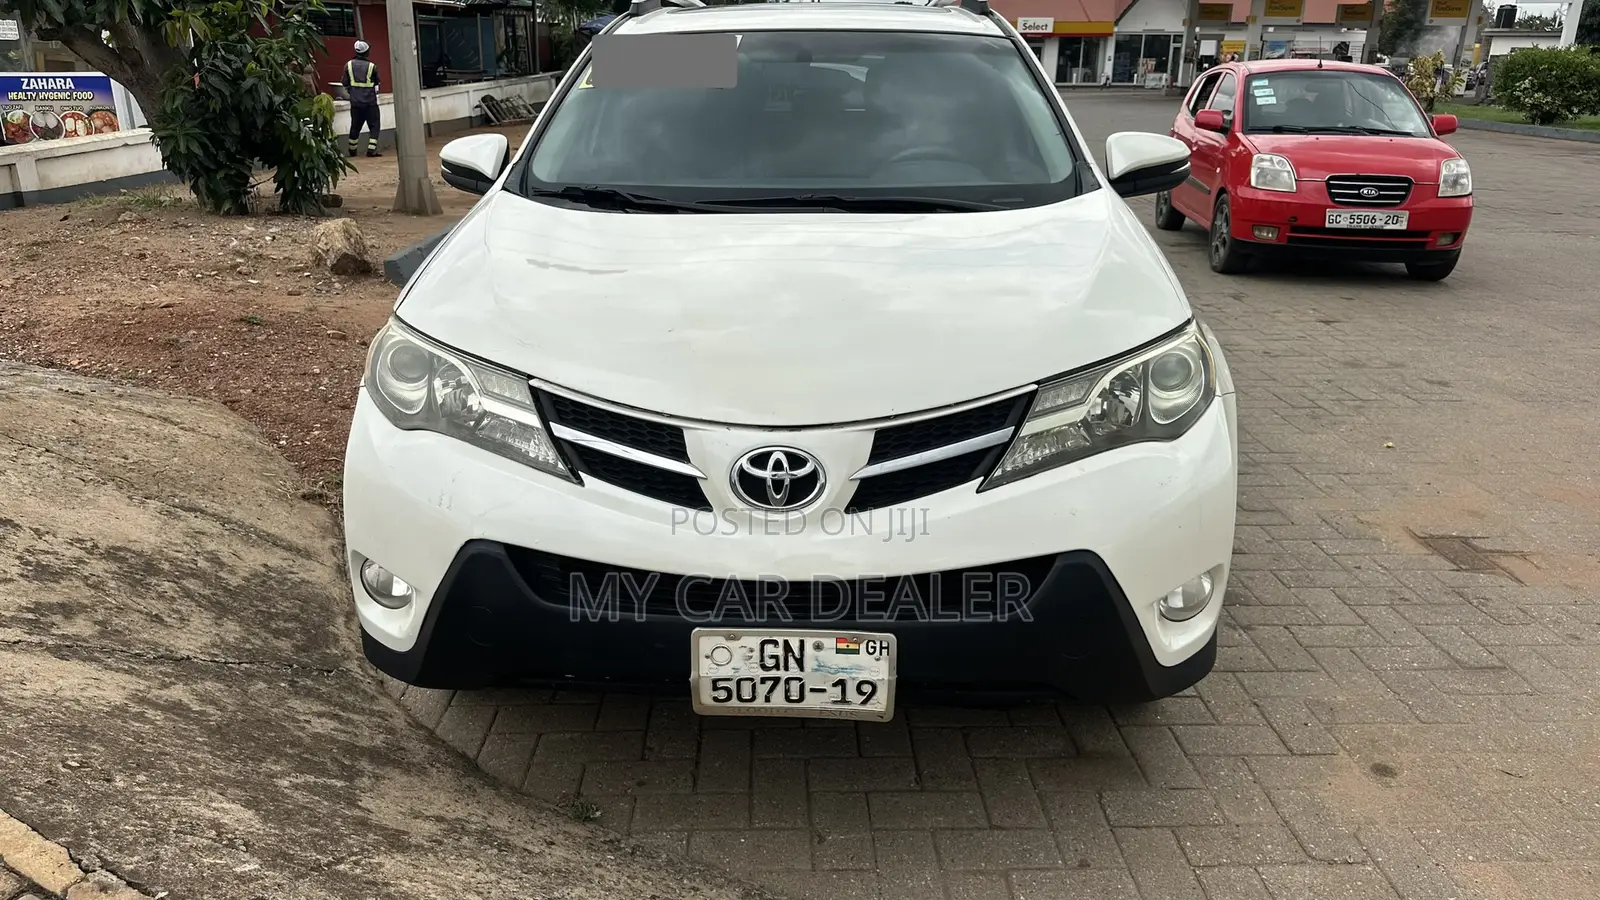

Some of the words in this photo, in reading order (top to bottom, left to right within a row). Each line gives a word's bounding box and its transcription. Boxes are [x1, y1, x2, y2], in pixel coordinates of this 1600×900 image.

[1022, 22, 1048, 31] Select
[20, 78, 75, 90] ZAHARA
[8, 91, 37, 100] HEALTY
[39, 91, 71, 100] HYGENIC
[73, 91, 94, 100] FOOD
[1328, 214, 1342, 225] GC
[866, 639, 889, 656] GH
[759, 639, 805, 672] GN
[711, 676, 878, 705] 5070-19
